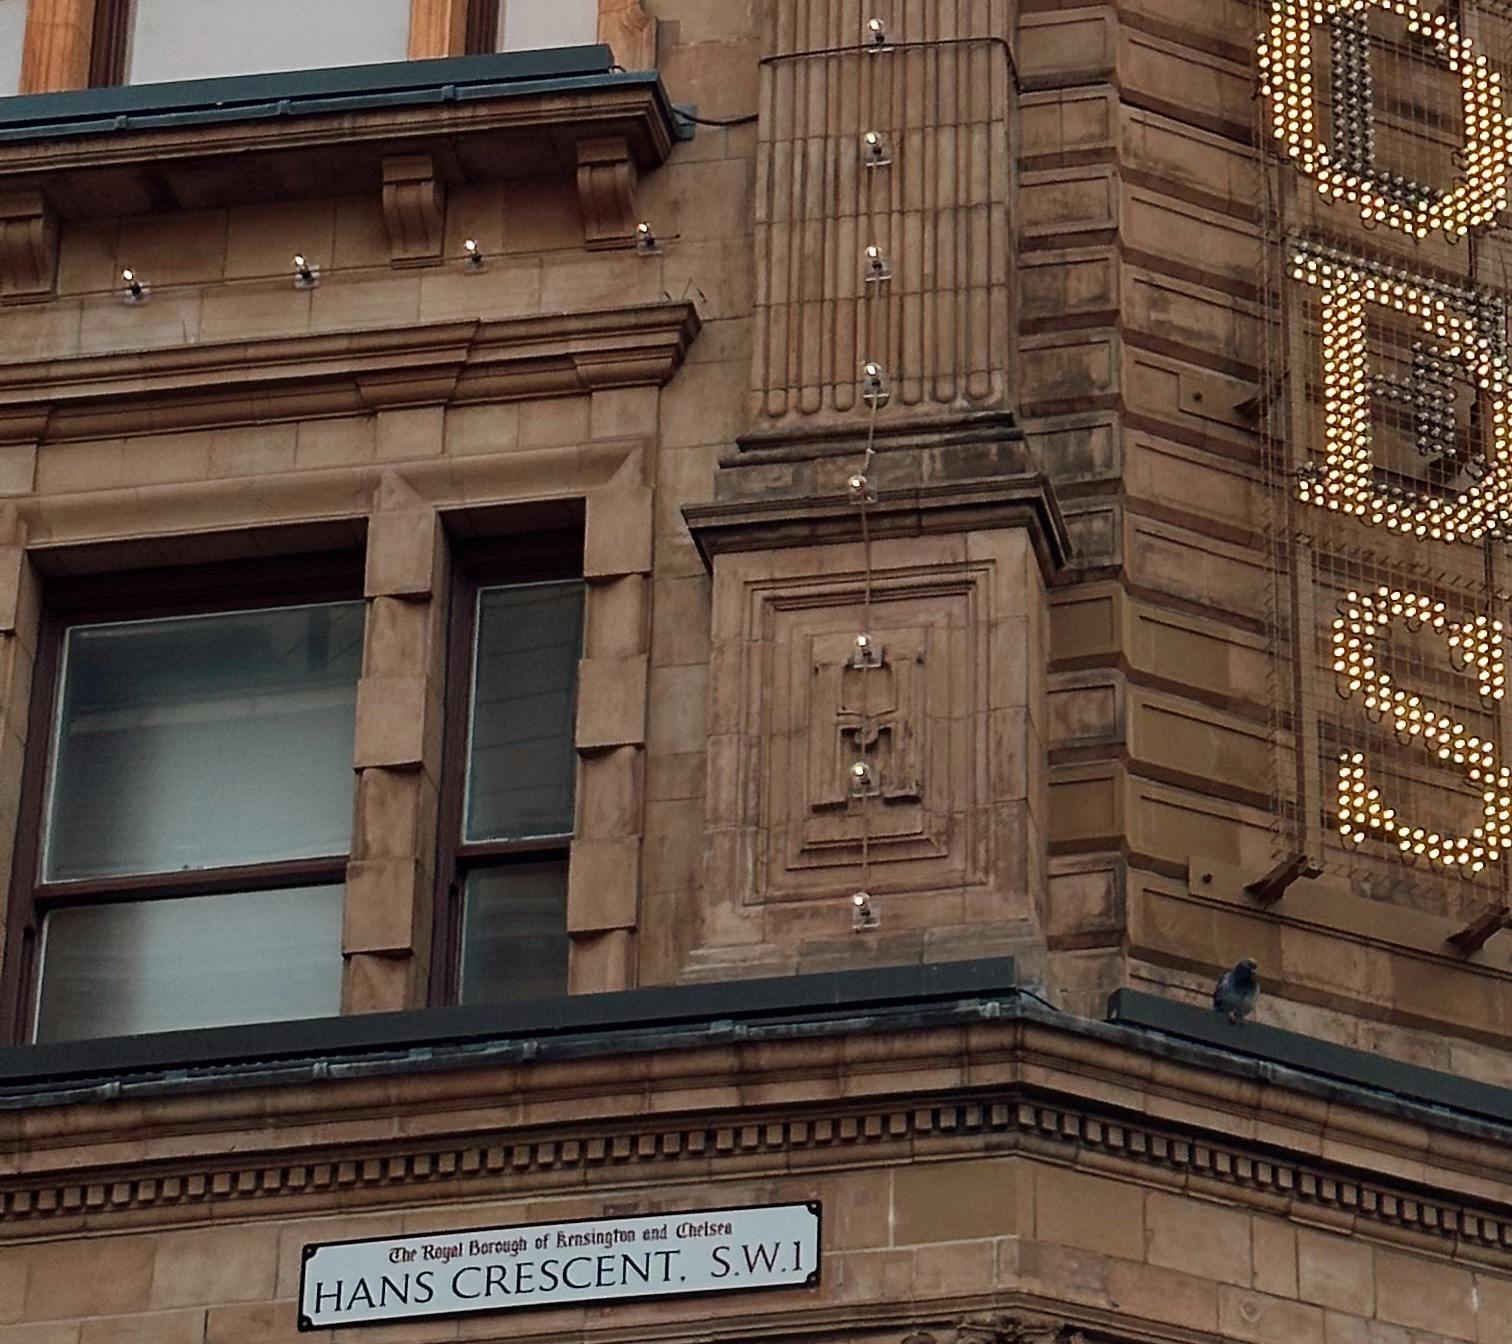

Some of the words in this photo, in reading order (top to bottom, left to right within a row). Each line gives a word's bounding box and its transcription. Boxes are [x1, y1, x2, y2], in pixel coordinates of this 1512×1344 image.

[389, 1247, 417, 1264] The
[421, 1242, 463, 1264] Royal
[469, 1236, 528, 1257] Borough
[535, 1233, 550, 1250] of
[556, 1226, 635, 1248] Kensington
[642, 1223, 667, 1240] and
[676, 1221, 732, 1239] Chelsea
[314, 1271, 434, 1313] HANS
